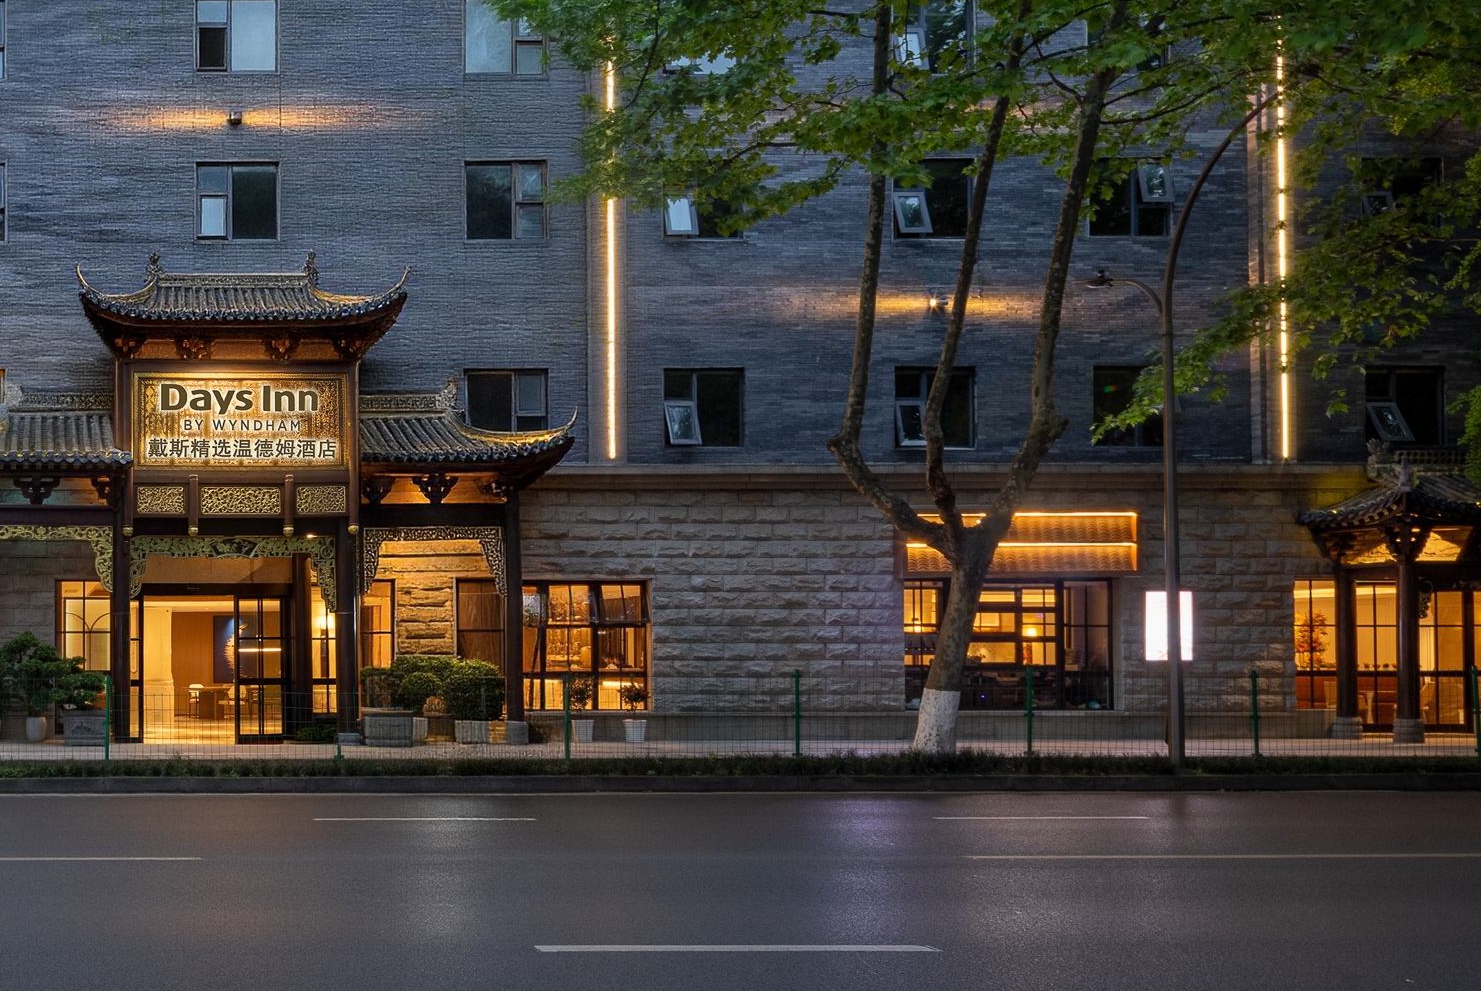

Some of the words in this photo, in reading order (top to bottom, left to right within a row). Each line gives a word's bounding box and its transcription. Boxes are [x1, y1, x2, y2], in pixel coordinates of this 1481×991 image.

[160, 383, 253, 415] Days
[262, 385, 319, 412] Inn
[184, 419, 204, 431] BY
[212, 419, 302, 432] WYNDHAM
[147, 437, 337, 459] 戴斯精选温德姆酒店
